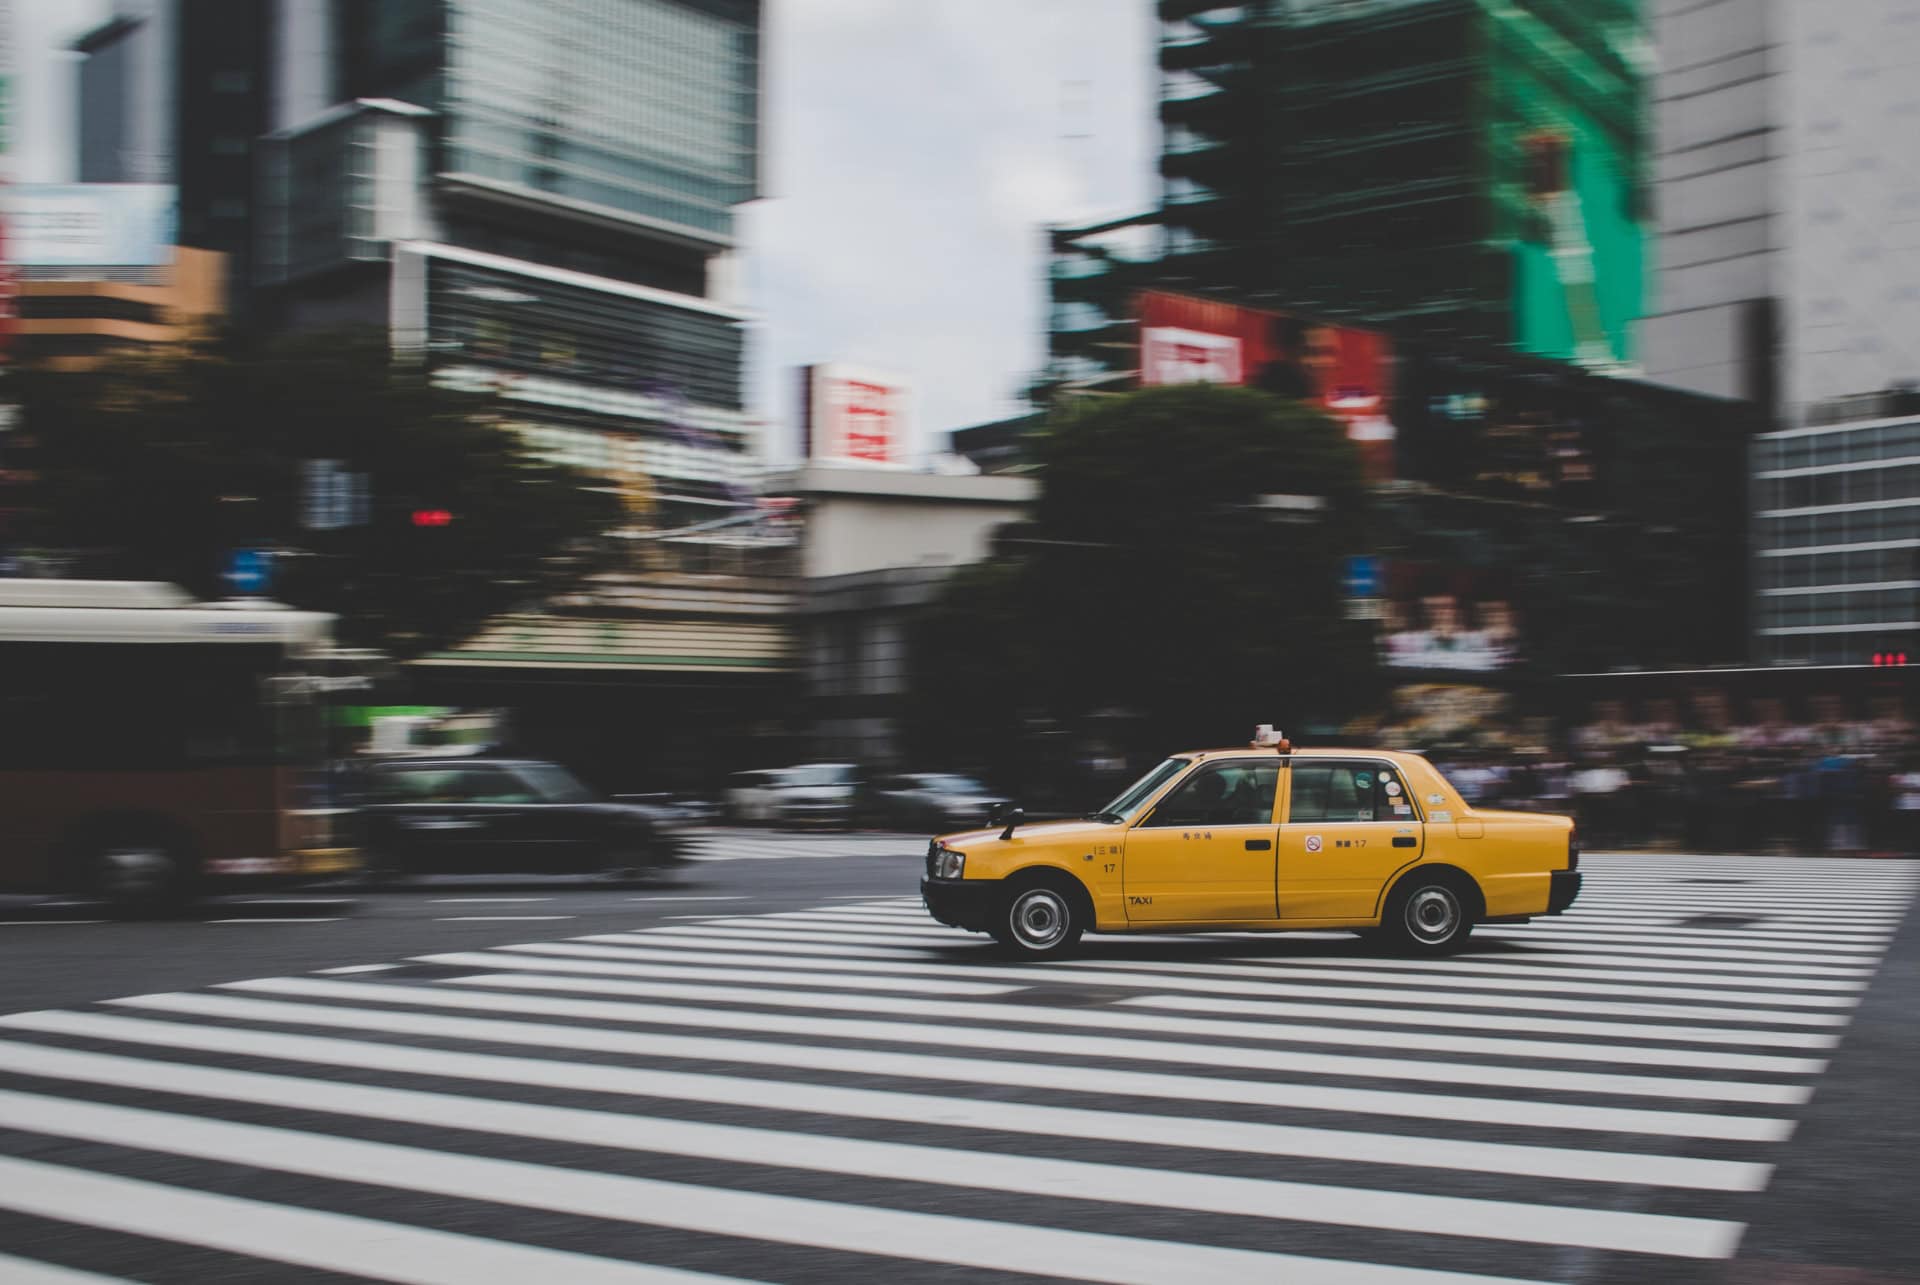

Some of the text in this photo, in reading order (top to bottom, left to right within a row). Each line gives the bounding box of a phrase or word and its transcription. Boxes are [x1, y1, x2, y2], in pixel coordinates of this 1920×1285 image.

[1354, 839, 1367, 848] 17
[1103, 863, 1116, 873] 17
[1128, 896, 1153, 905] TAXI
